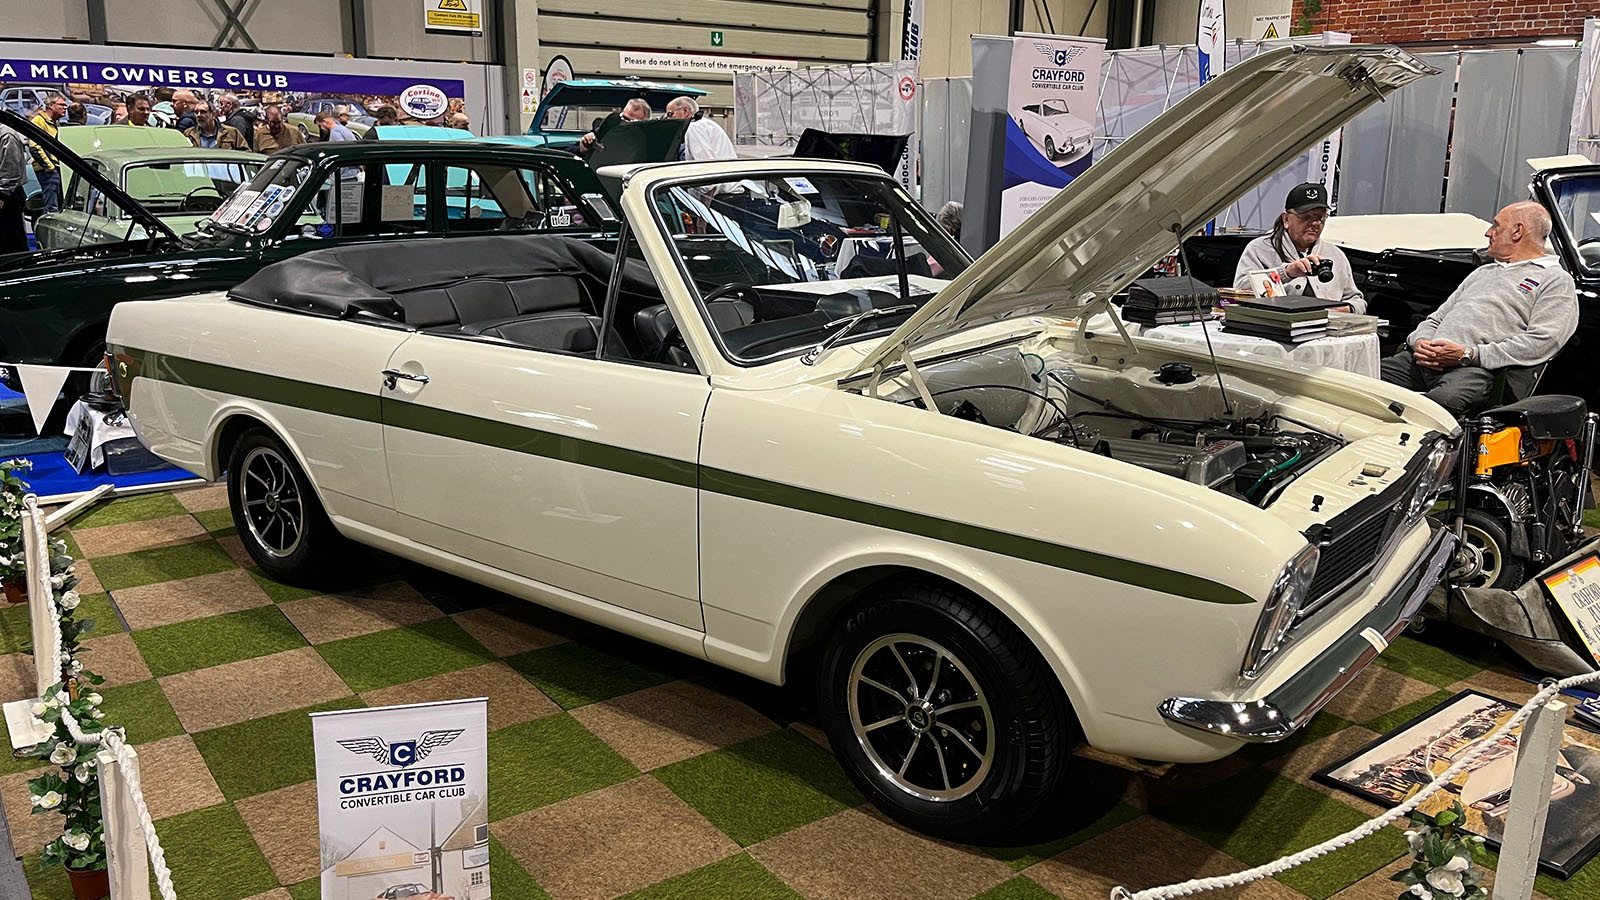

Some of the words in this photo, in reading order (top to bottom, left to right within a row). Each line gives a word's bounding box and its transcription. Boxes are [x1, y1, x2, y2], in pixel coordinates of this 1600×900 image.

[690, 60, 707, 68] front
[729, 63, 763, 72] emergency
[0, 63, 17, 78] A
[30, 64, 88, 80] MKII
[101, 67, 215, 85] OWNERS
[226, 73, 288, 88] CLUB
[1032, 69, 1085, 82] CRAYFORD
[407, 90, 440, 98] Cortina
[339, 767, 465, 794] CRAYFORD
[340, 793, 412, 809] CONVERTIBLE
[415, 790, 435, 801] CAR
[439, 788, 465, 798] CLUB
